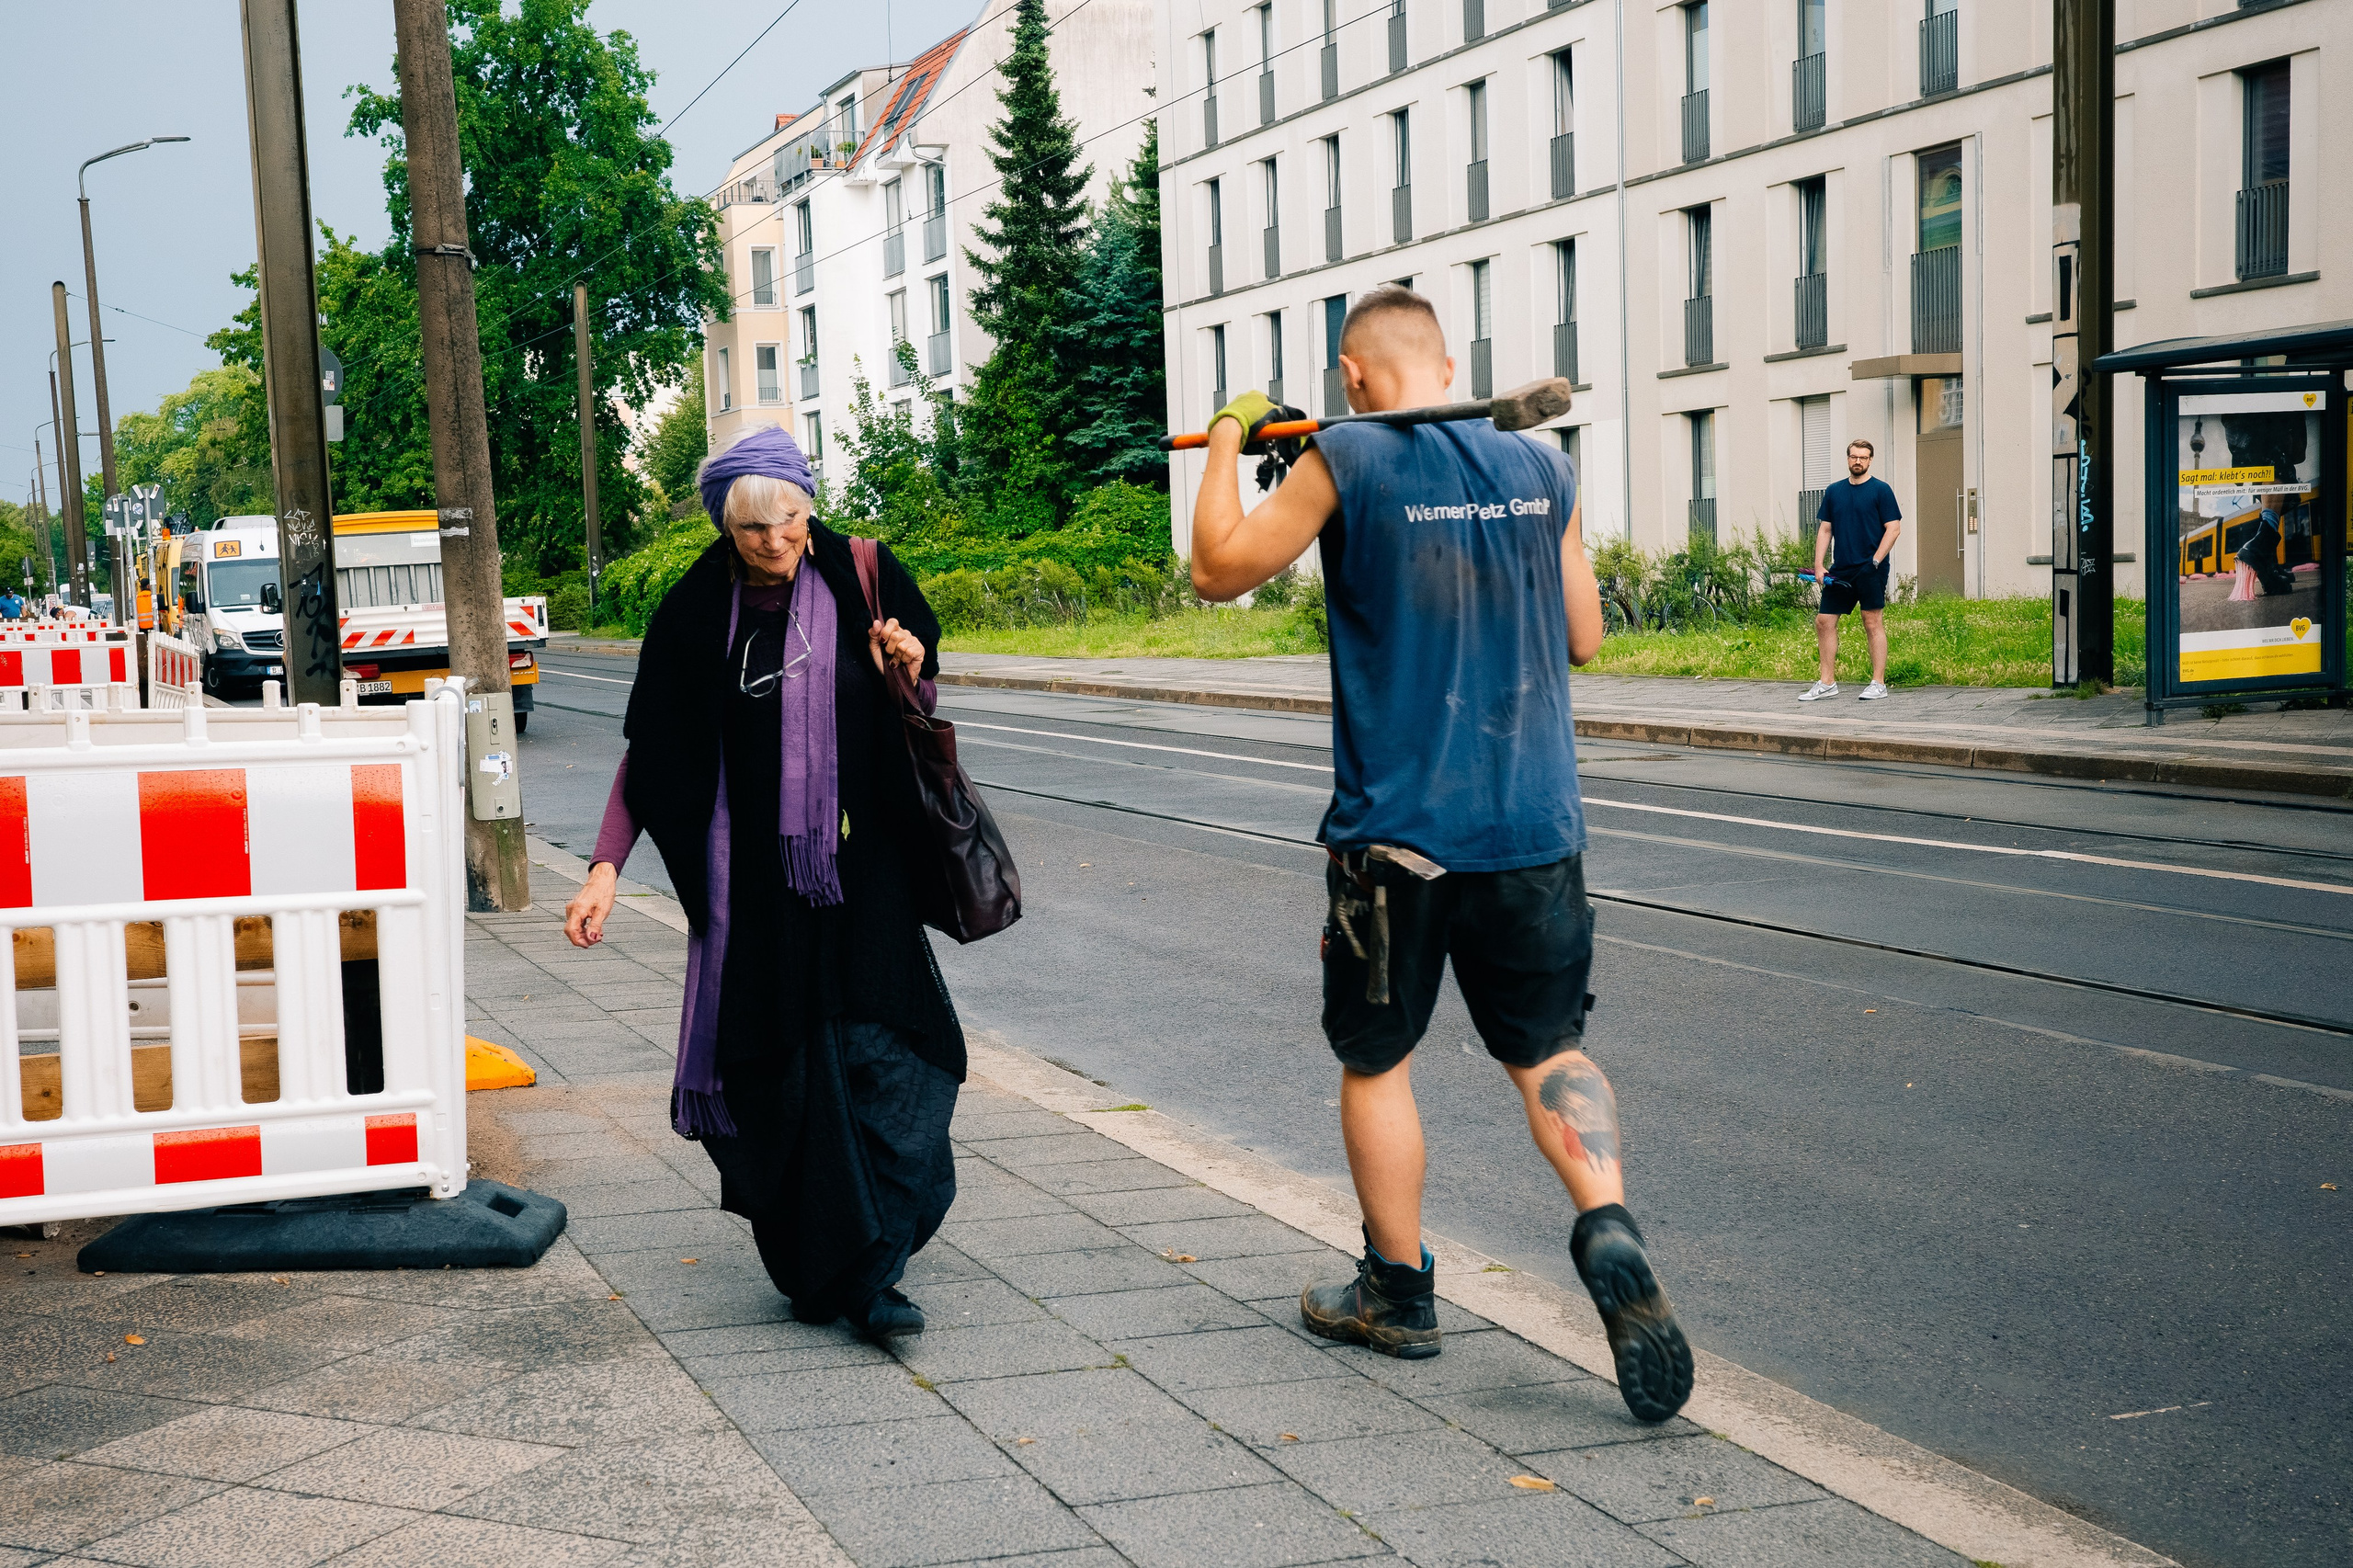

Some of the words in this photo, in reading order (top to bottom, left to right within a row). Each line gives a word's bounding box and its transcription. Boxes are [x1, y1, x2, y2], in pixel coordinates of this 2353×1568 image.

[2180, 473, 2199, 484] Sagt
[2200, 472, 2217, 482] mal:
[2219, 470, 2245, 481] klebt's
[2247, 469, 2272, 479] noch?!
[2256, 486, 2272, 494] weniger
[368, 682, 391, 692] 1882
